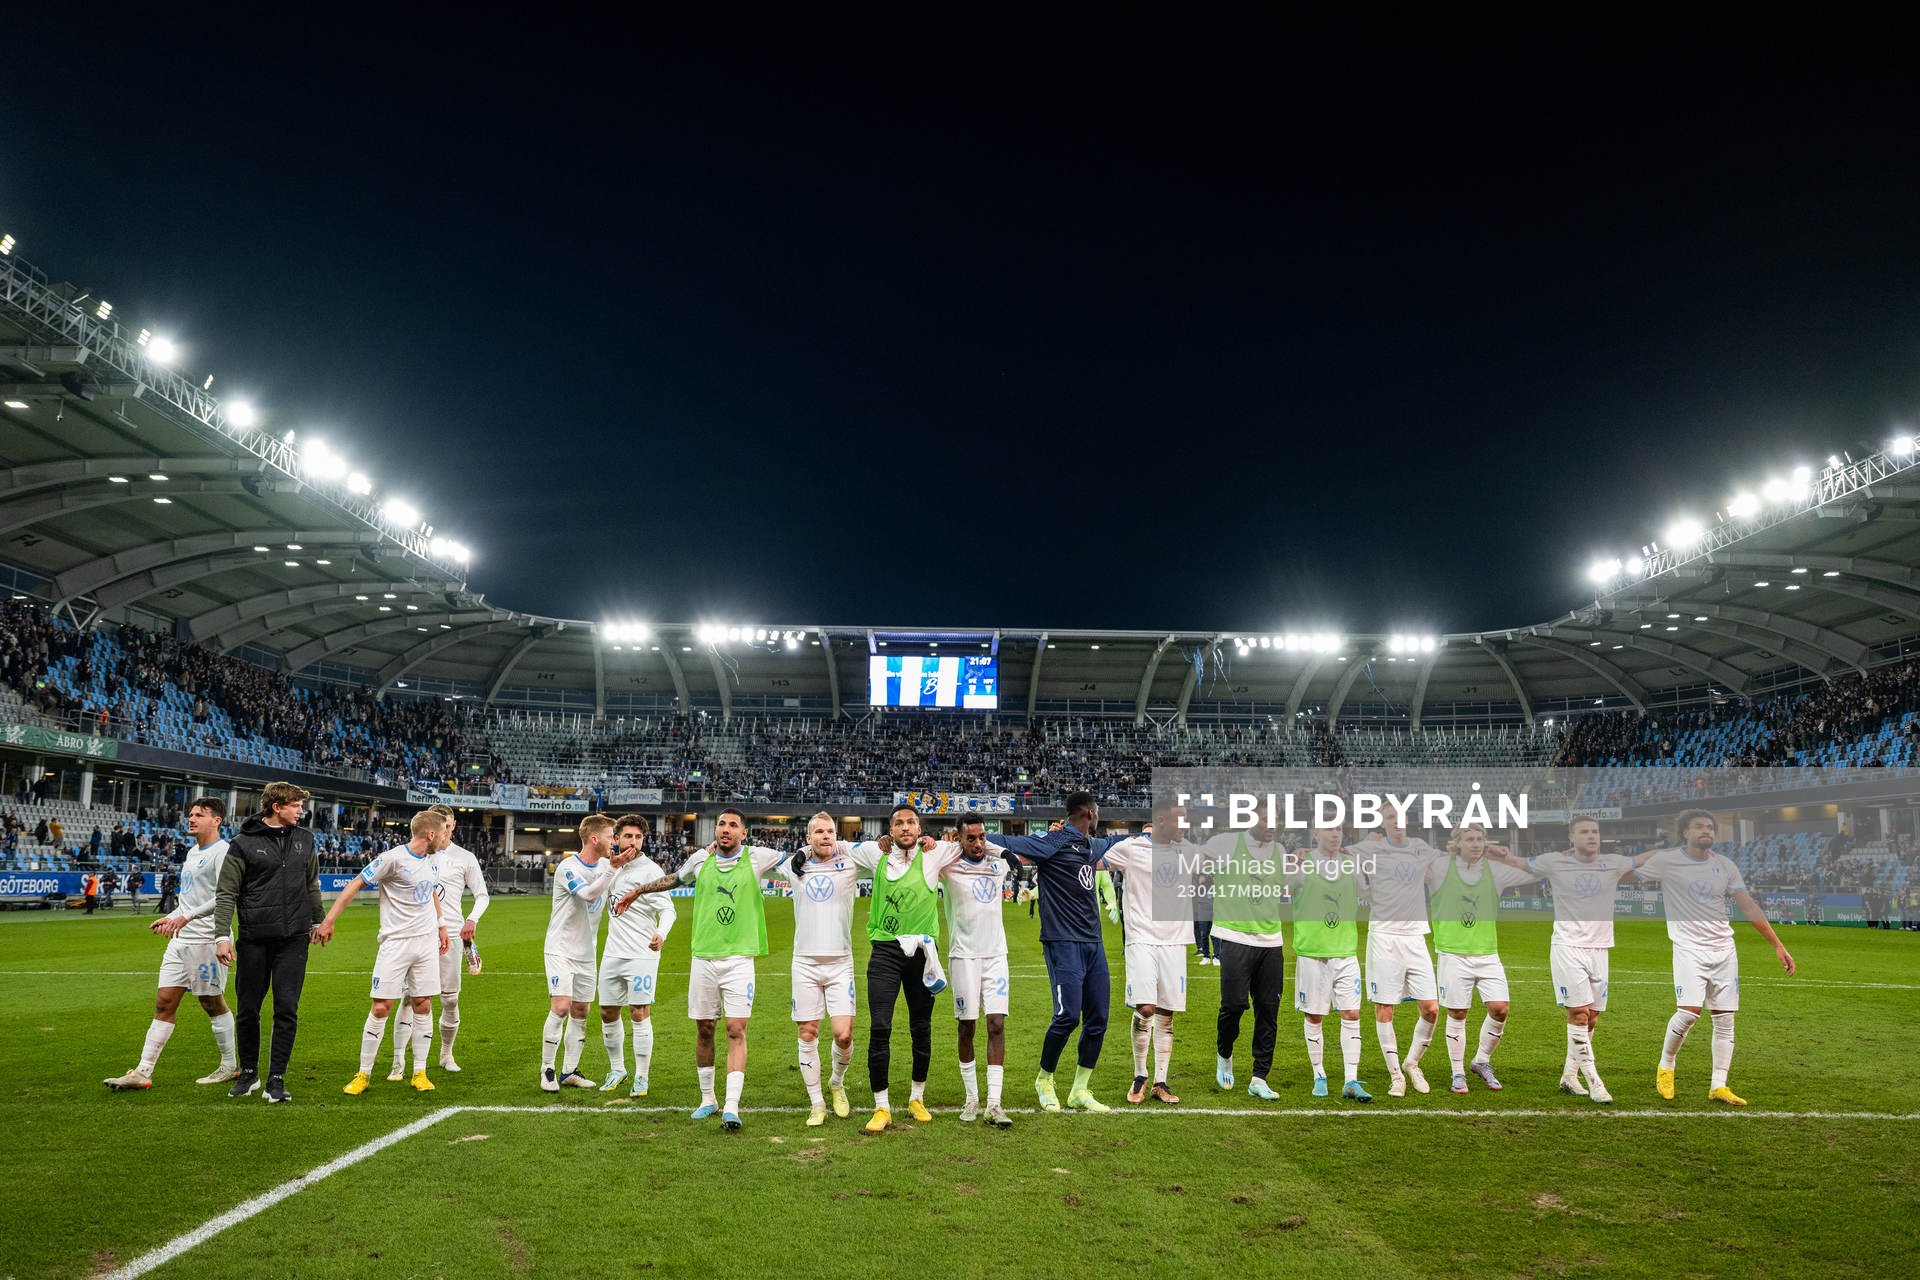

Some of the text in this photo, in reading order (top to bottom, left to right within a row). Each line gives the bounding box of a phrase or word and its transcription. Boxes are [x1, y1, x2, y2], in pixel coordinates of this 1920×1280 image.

[530, 800, 586, 810] merinfo.se
[953, 795, 1011, 813] RAS
[0, 875, 58, 893] GÖTEBORG
[198, 962, 217, 980] 21
[633, 975, 652, 992] 20
